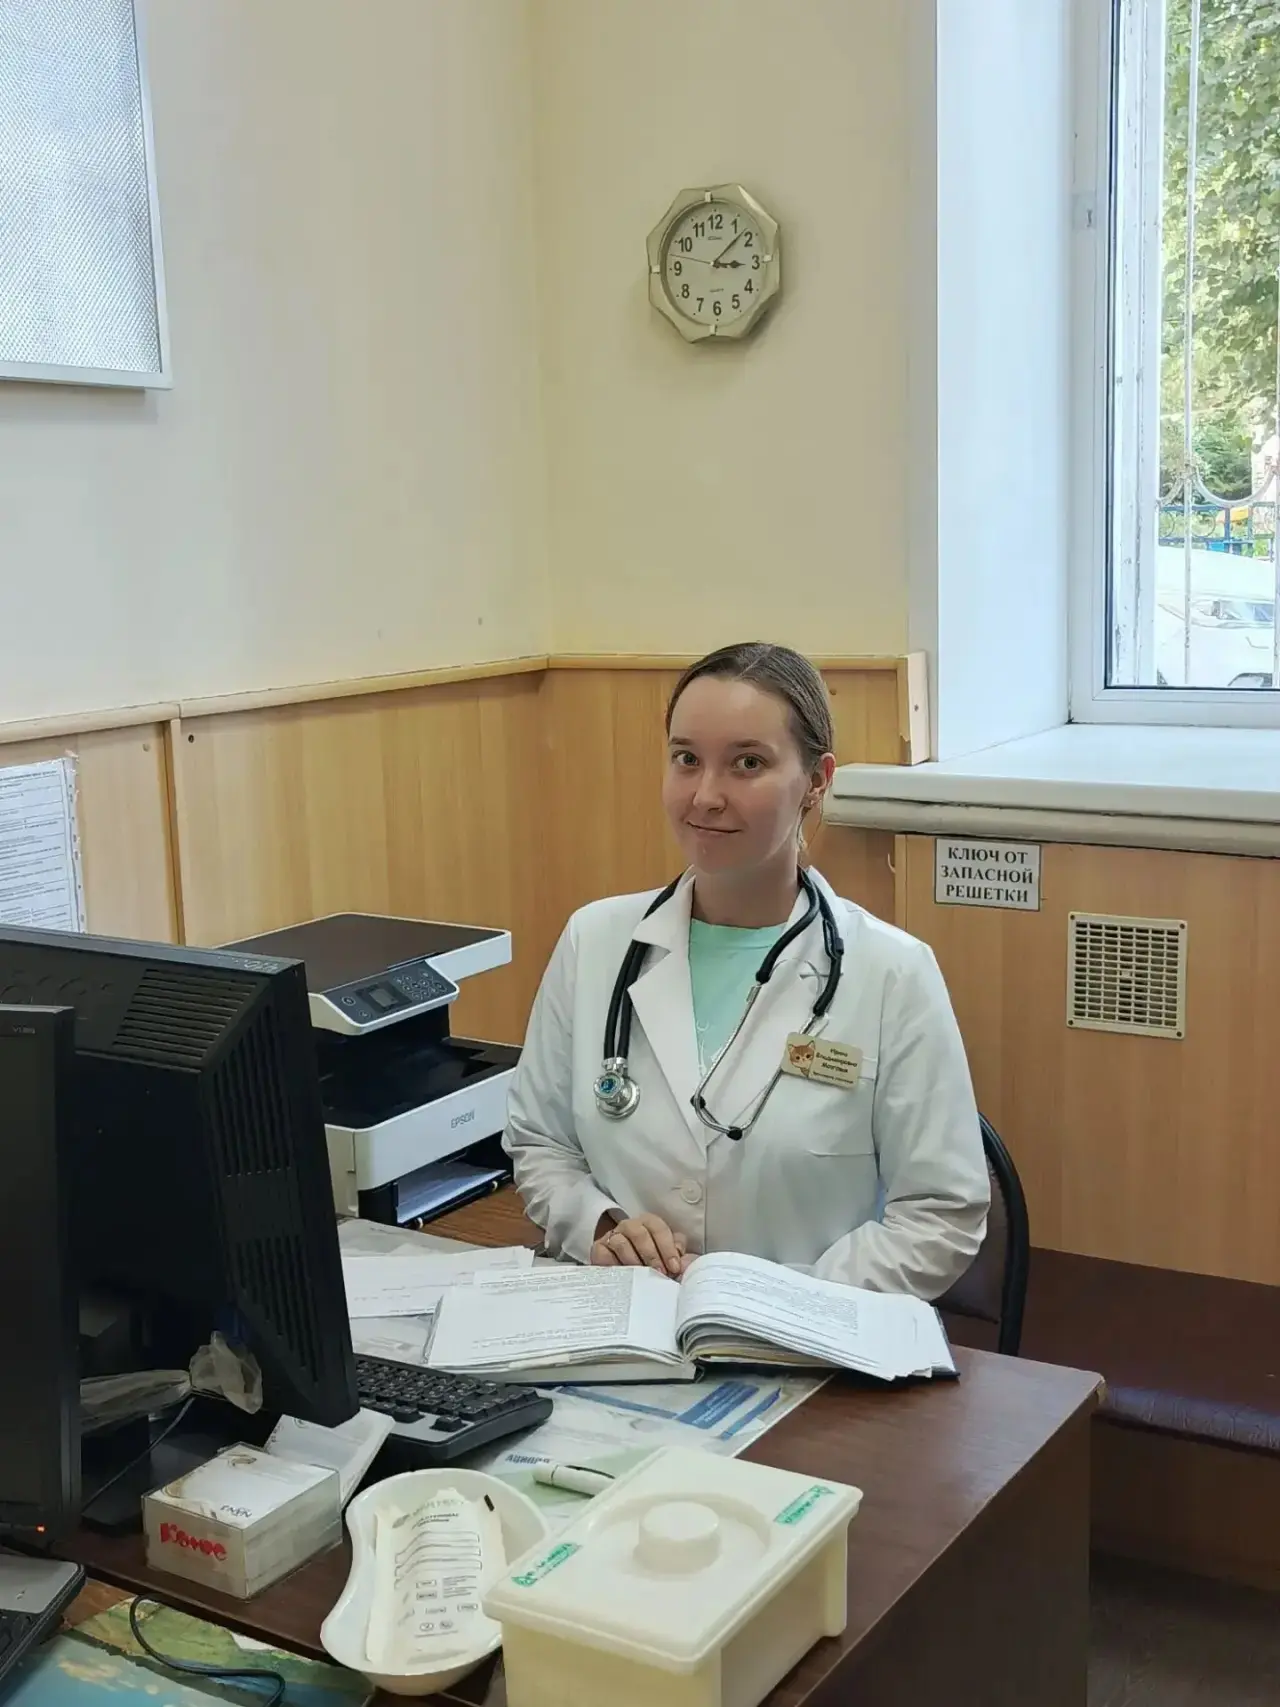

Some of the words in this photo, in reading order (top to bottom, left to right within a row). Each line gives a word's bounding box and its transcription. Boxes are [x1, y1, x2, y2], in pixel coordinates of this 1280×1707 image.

[692, 222, 705, 238] 11
[707, 214, 723, 230] 12
[731, 218, 738, 234] 1
[678, 236, 693, 252] 10
[744, 231, 753, 247] 2
[674, 261, 682, 276] 9
[751, 255, 760, 270] 3
[681, 283, 690, 299] 8
[744, 278, 754, 293] 4
[696, 297, 704, 312] 7
[712, 301, 722, 316] 6
[731, 294, 740, 309] 5
[948, 846, 999, 862] КЛЮЧ
[1004, 851, 1028, 864] ОТ
[940, 865, 1033, 884] ЗАПАСНОЙ
[946, 884, 1028, 903] РЕШЕТКИ
[450, 1109, 475, 1129] EPSON
